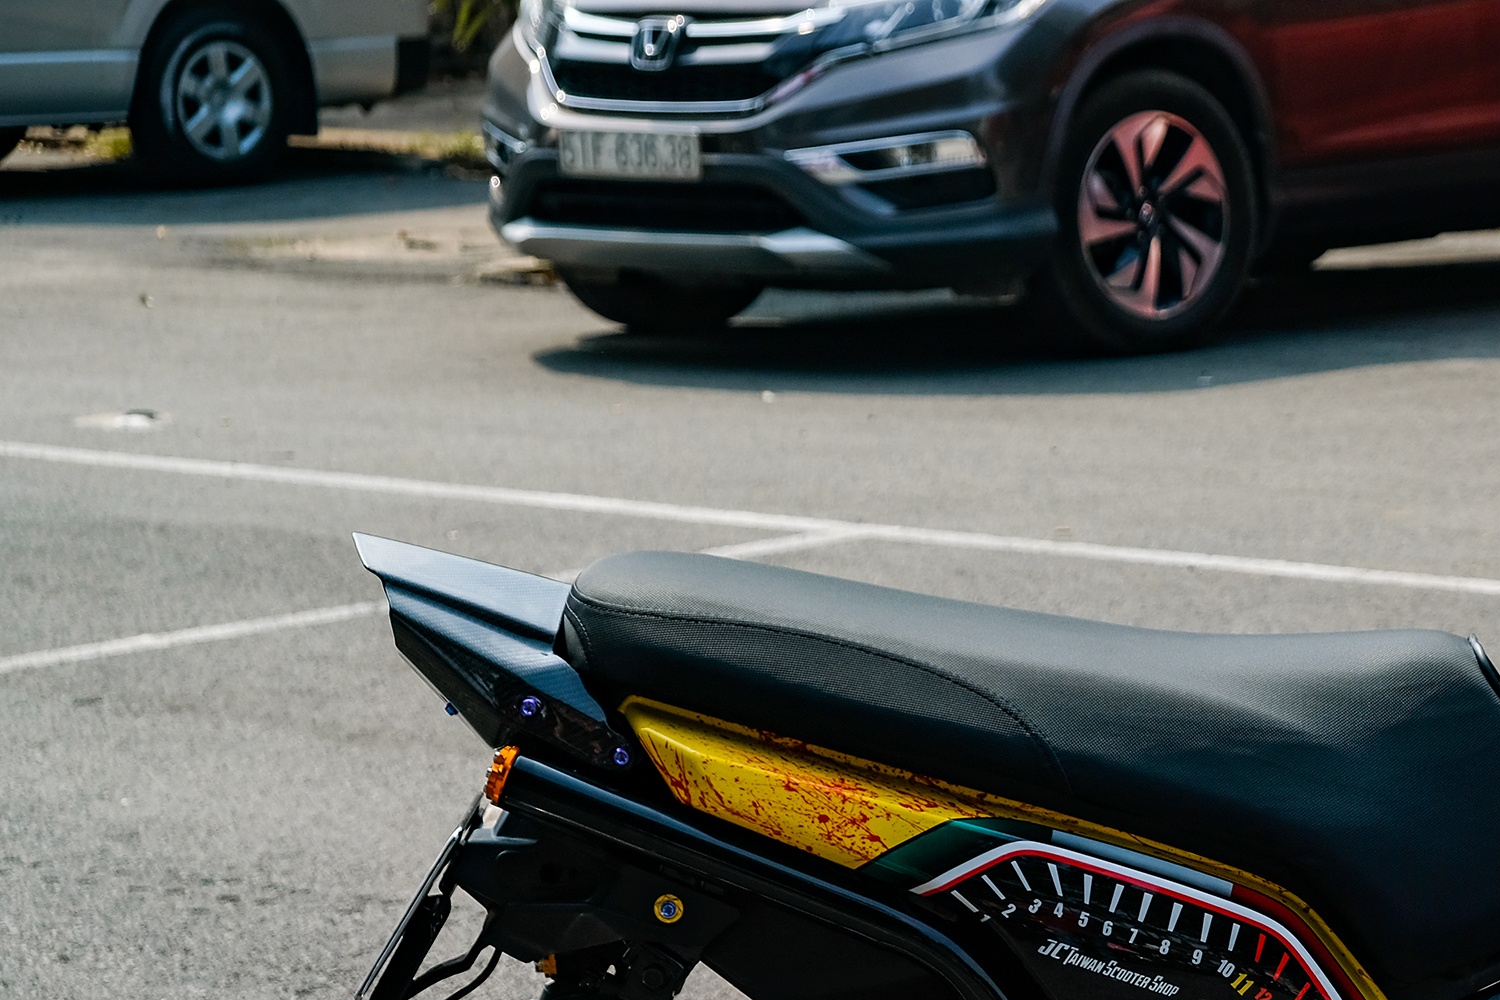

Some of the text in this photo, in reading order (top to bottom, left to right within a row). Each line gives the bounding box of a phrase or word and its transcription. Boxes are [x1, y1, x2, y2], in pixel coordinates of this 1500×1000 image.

[1001, 903, 1017, 919] 2
[1028, 898, 1043, 914] 3
[1053, 902, 1064, 918] 4
[1077, 911, 1090, 928] 5
[1102, 920, 1114, 937] 6
[1128, 927, 1139, 944] 7
[1159, 939, 1171, 955] 8
[1191, 949, 1203, 965] 9
[1216, 959, 1236, 978] 10
[1230, 972, 1255, 996] 11
